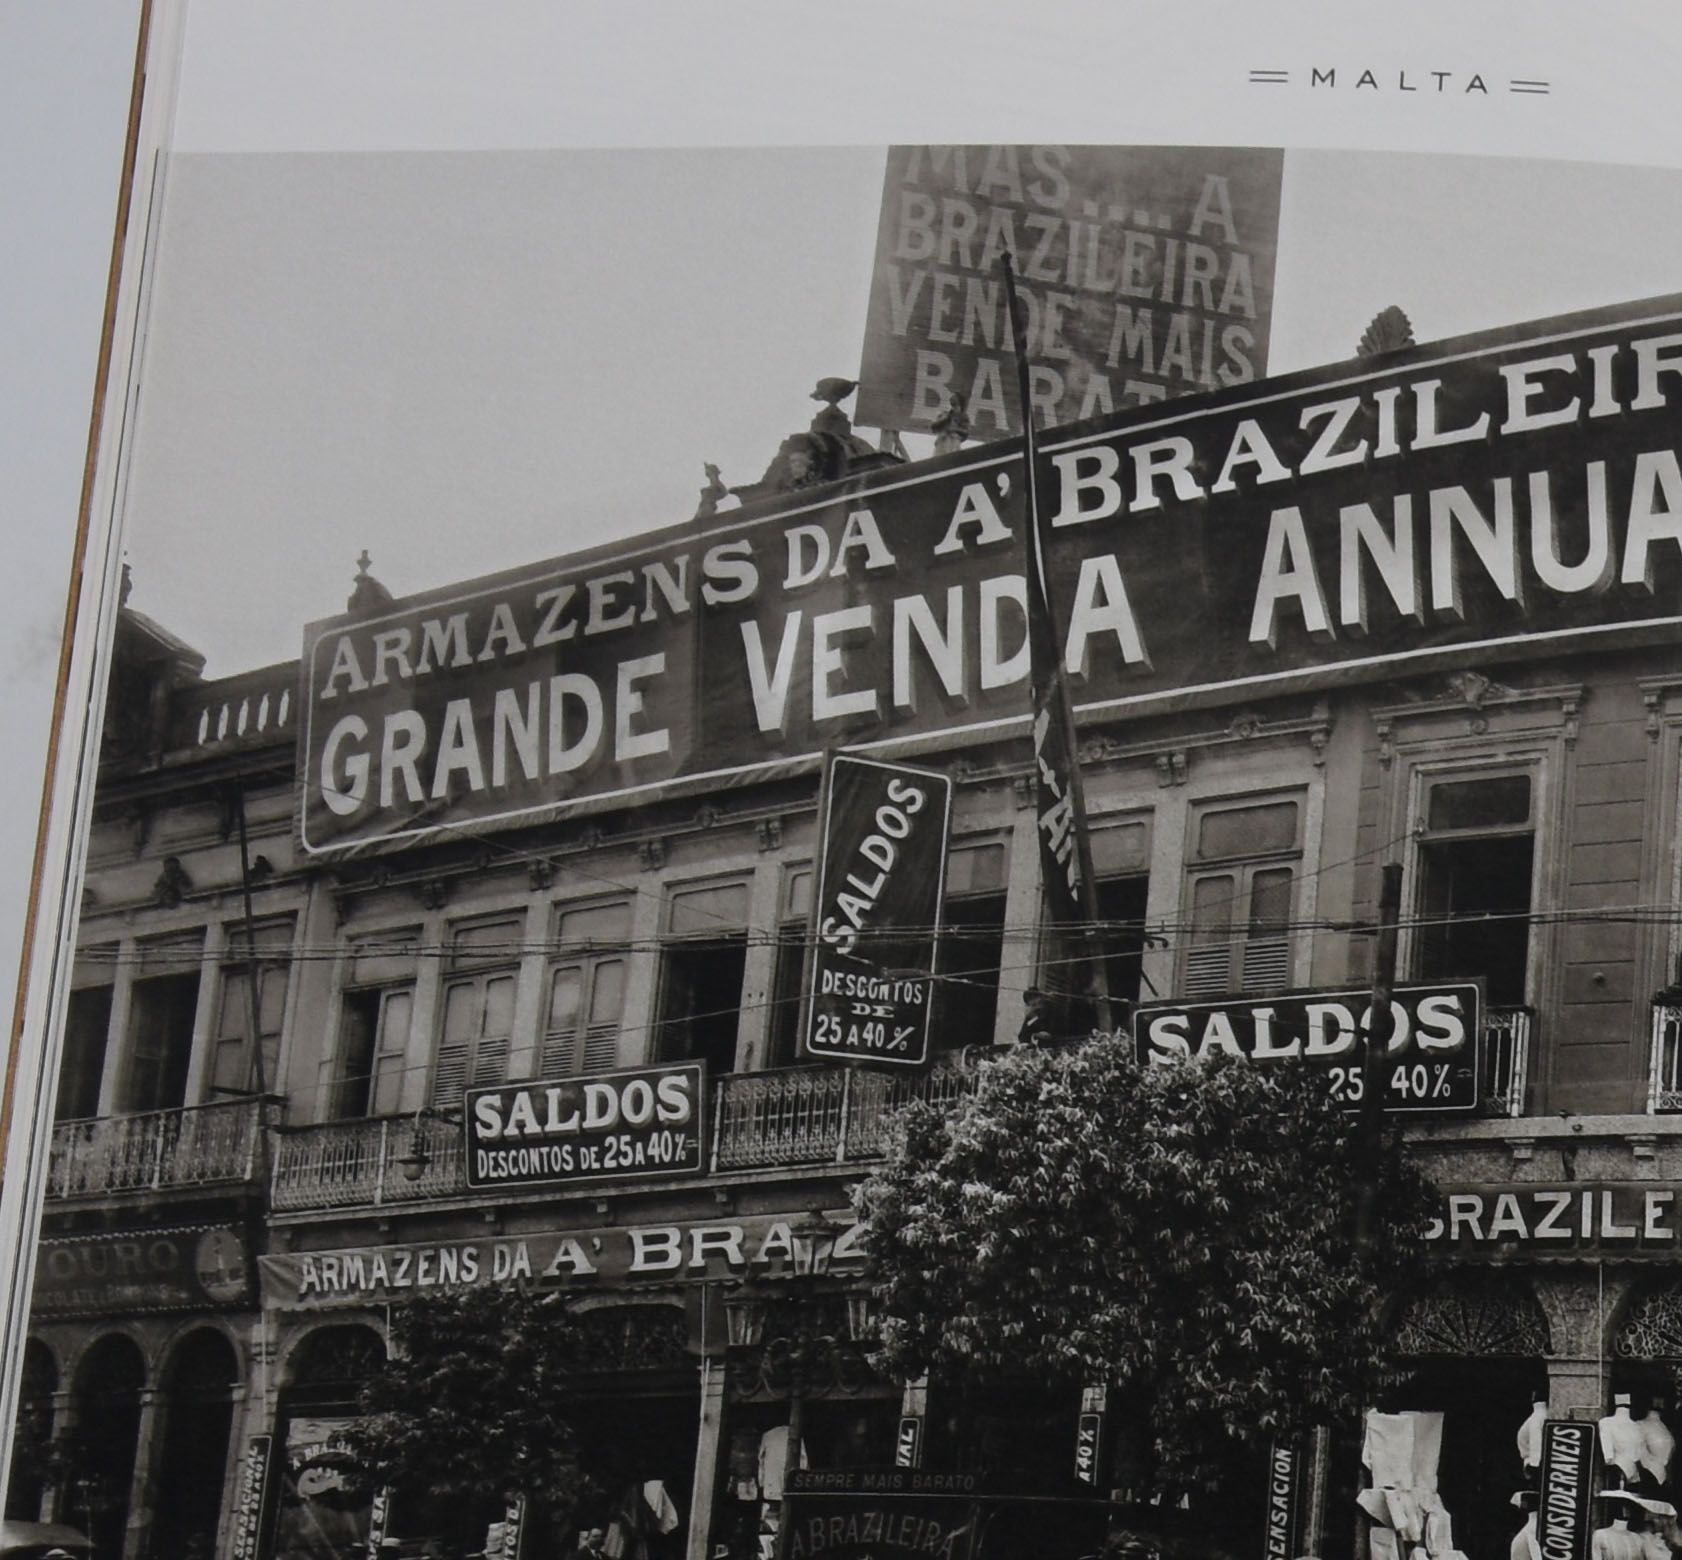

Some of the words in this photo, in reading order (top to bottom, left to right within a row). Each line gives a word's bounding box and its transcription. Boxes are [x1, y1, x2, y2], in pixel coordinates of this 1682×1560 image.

[1311, 67, 1489, 95] MALTA
[1189, 174, 1239, 246] A
[896, 190, 1257, 319] BRAZILEIRA
[887, 263, 1076, 362] VENDE
[1106, 303, 1256, 386] MAIS
[320, 538, 759, 700] ARMAZENS
[782, 508, 897, 592] DA
[933, 472, 1013, 556] A'
[320, 652, 671, 816] GRANDE
[740, 553, 1150, 732] VENDA
[821, 778, 924, 955] SALDOS
[821, 968, 923, 1005] DESCONTOS
[851, 1002, 895, 1019] DE
[815, 1014, 843, 1044] 25
[846, 1024, 860, 1047] A
[1148, 995, 1466, 1065] SALDOS
[475, 1075, 691, 1140] SALDOS
[1390, 1064, 1451, 1098] 40%
[478, 1144, 574, 1179] DESCONTOS
[580, 1146, 601, 1171] DE
[603, 1134, 633, 1169] 25
[635, 1141, 646, 1166] A
[649, 1130, 687, 1163] 40%
[300, 1245, 479, 1294] ARMAZENS
[493, 1240, 532, 1280] DA
[548, 1239, 601, 1276] A'
[233, 1446, 258, 1559] SENSACIONAL
[793, 1473, 855, 1489] SEMPRE
[862, 1473, 904, 1490] MAIS
[912, 1474, 976, 1491] BARATO
